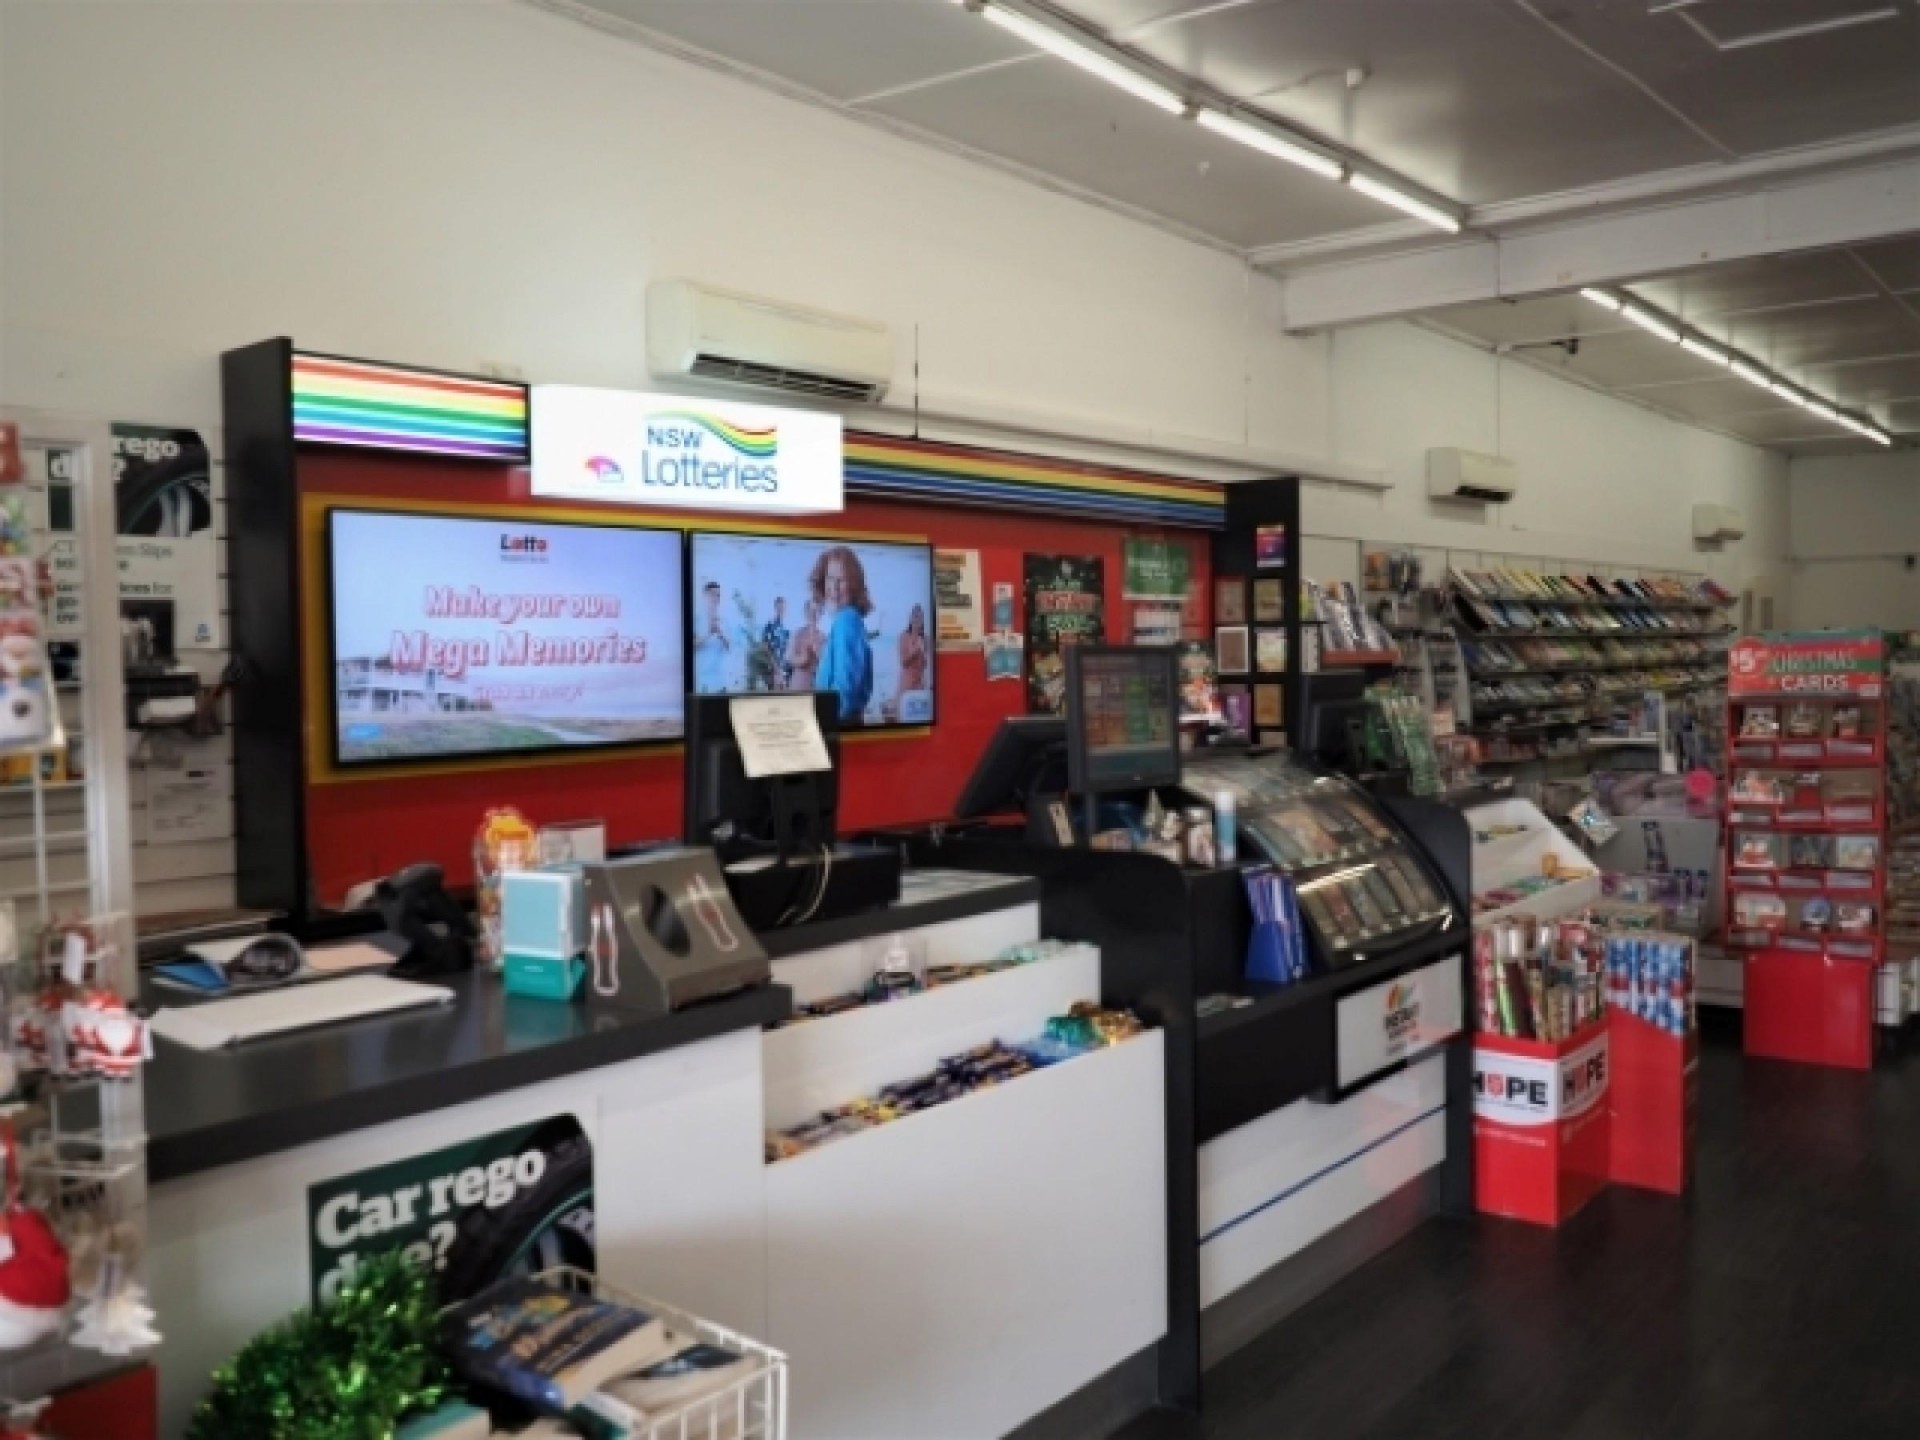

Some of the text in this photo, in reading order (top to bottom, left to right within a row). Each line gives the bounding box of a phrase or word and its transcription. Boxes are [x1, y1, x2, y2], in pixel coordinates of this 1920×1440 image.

[647, 426, 702, 448] NSW
[641, 450, 778, 492] Lotteries
[424, 585, 621, 624] Make your own
[390, 629, 649, 679] Mega Memories
[1781, 674, 1849, 691] CARDS
[316, 1149, 547, 1248] Car rego
